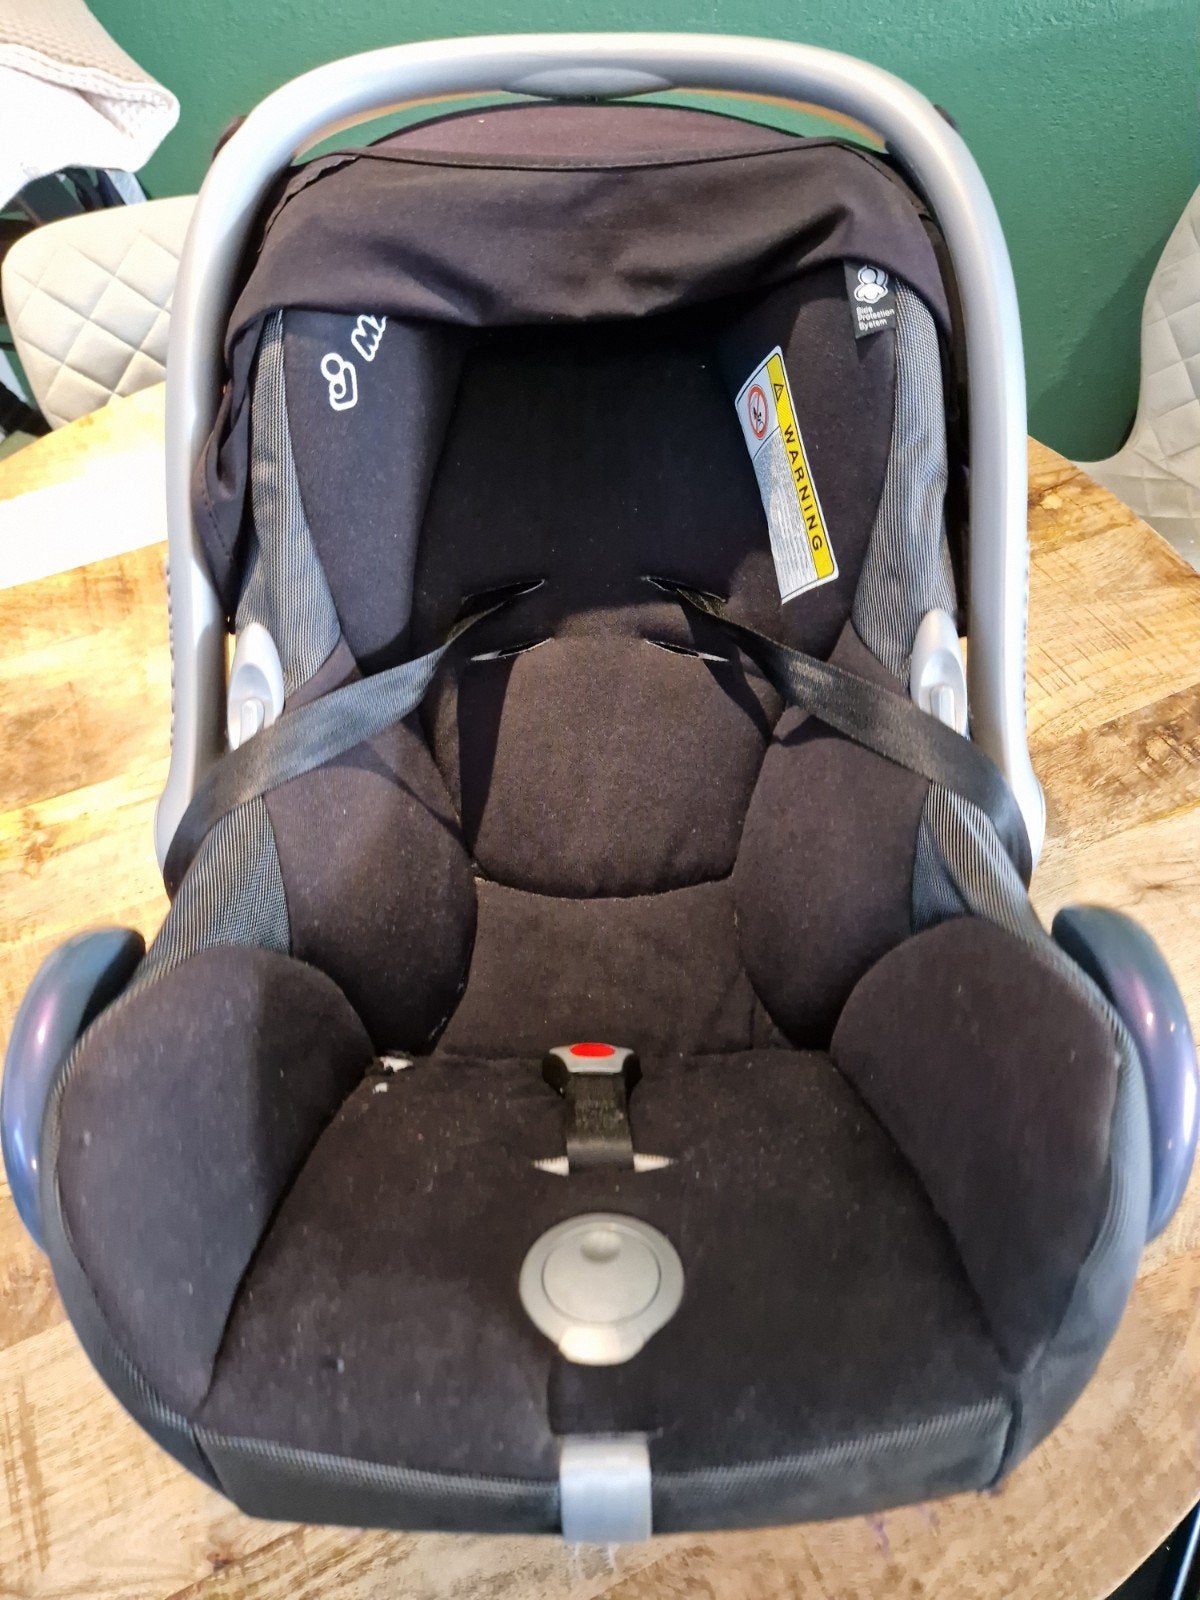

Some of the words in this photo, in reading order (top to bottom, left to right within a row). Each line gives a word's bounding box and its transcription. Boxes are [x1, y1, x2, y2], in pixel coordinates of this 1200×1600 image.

[857, 309, 894, 321] Protection
[859, 319, 887, 331] System
[784, 423, 823, 551] WARNING
